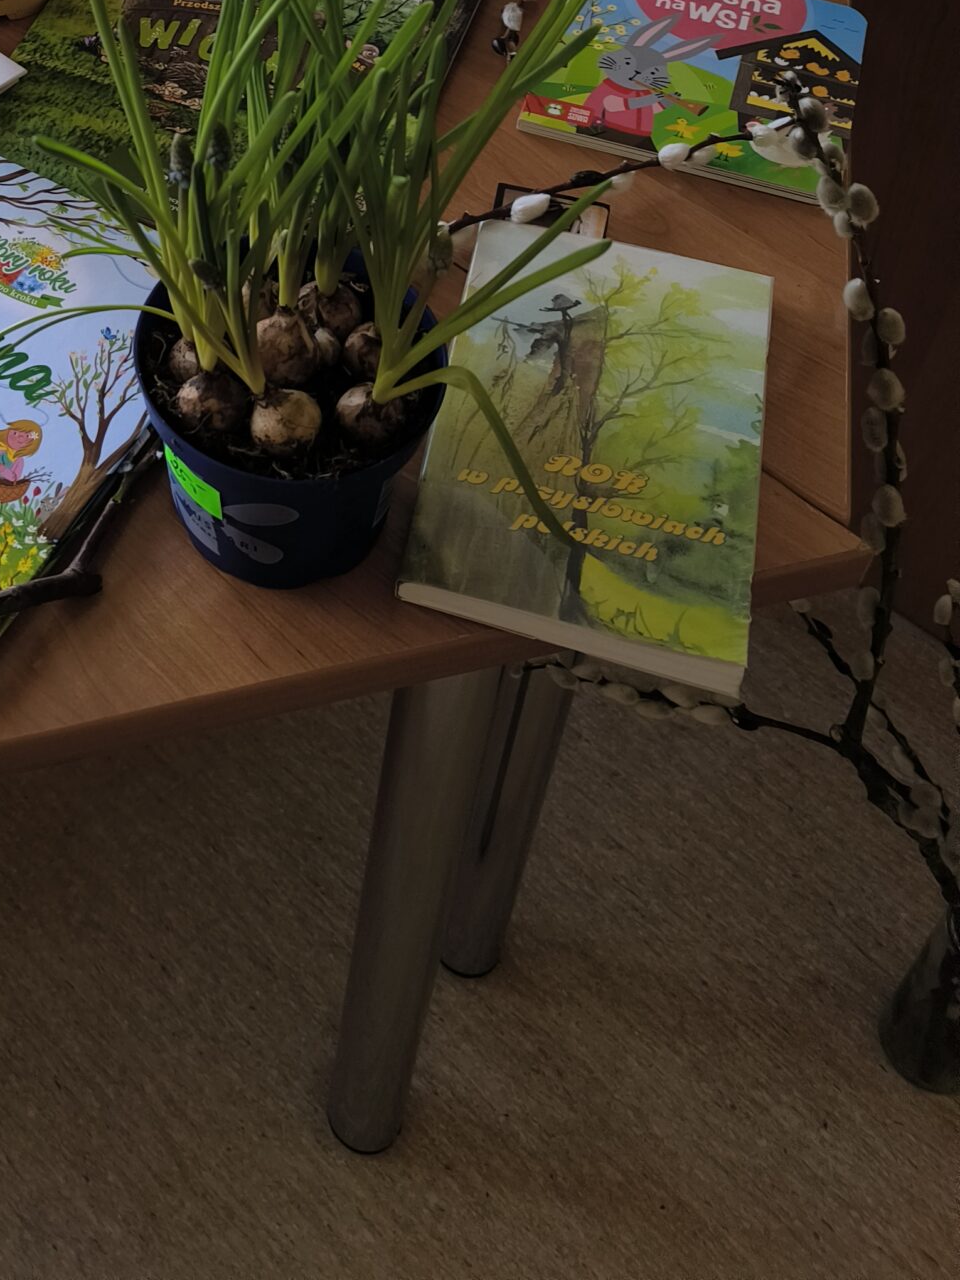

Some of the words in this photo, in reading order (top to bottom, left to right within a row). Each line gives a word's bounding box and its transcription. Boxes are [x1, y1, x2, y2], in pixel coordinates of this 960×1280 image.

[28, 265, 78, 294] roku
[10, 288, 39, 306] kroku
[456, 466, 489, 485] w
[544, 454, 651, 495] ROK
